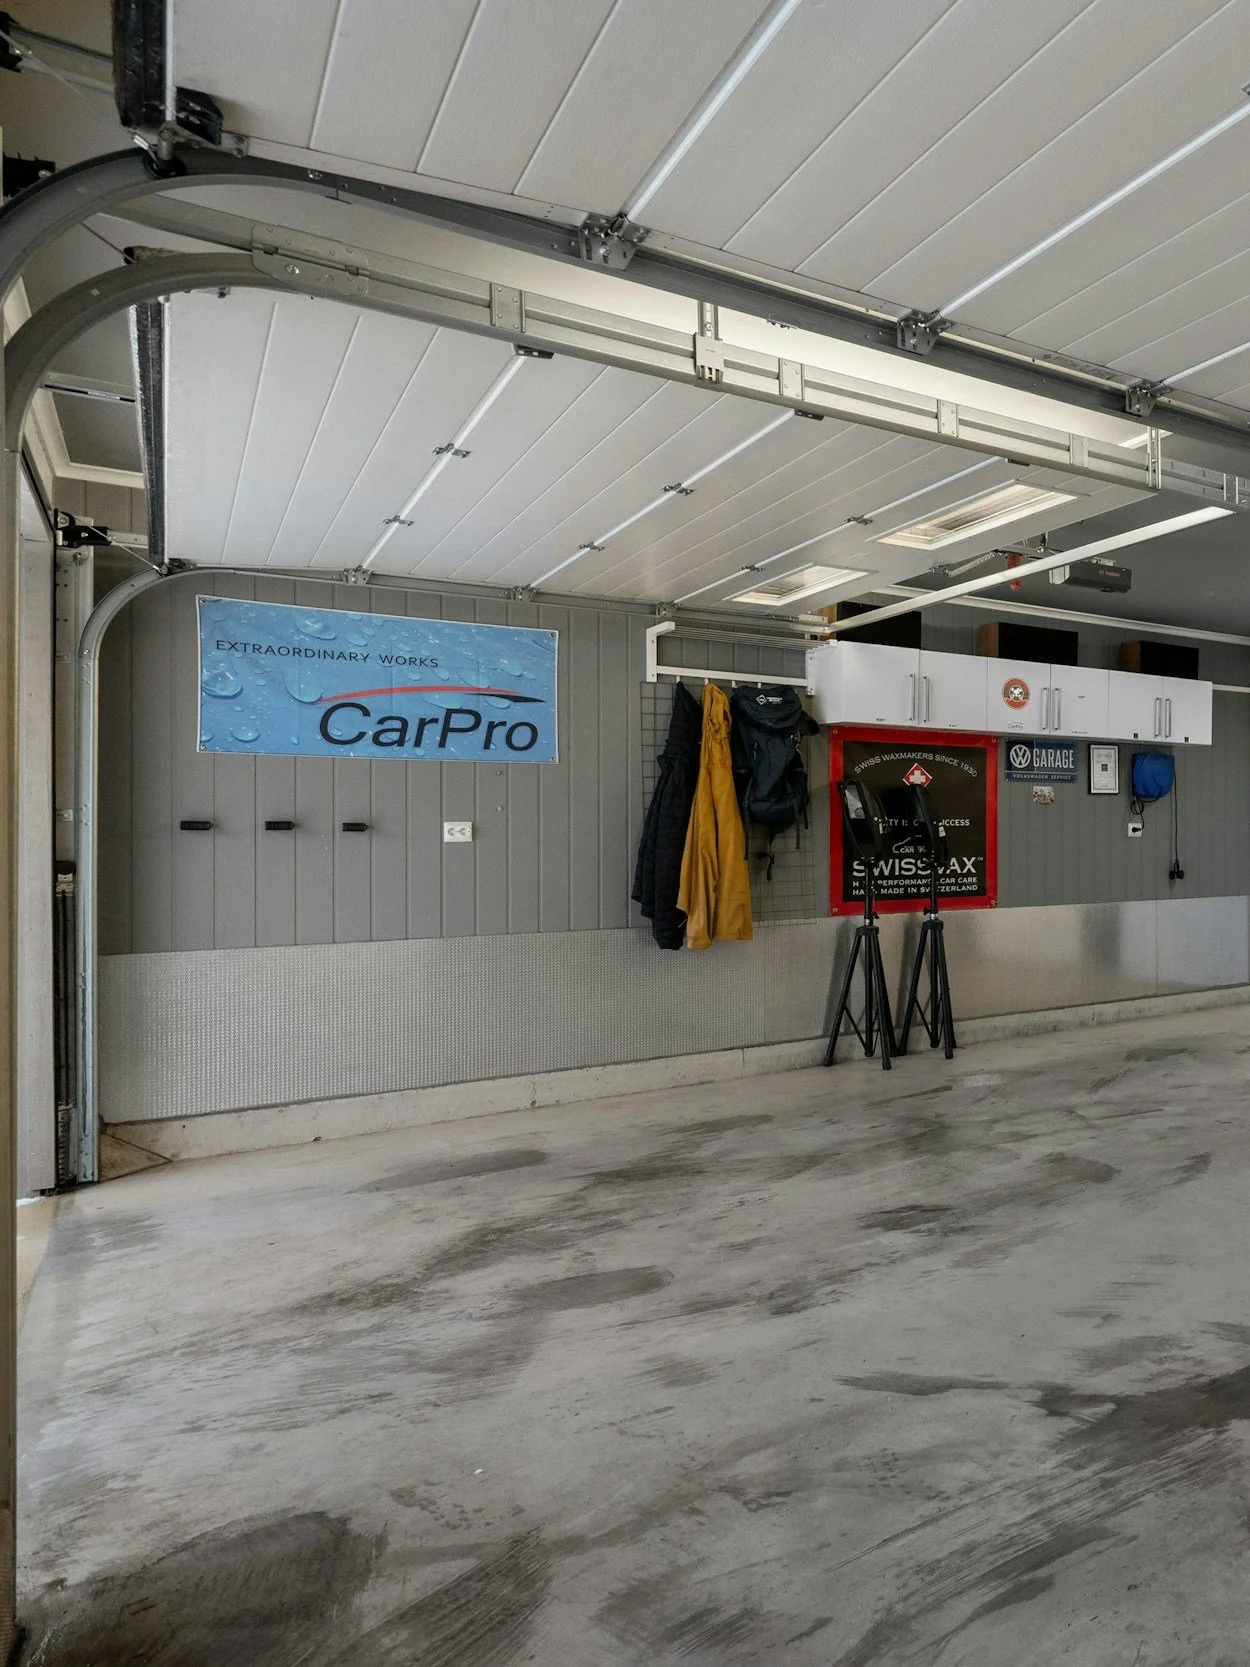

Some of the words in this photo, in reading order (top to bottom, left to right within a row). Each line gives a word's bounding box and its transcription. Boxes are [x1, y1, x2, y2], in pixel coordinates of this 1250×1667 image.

[216, 639, 371, 663] EXTRAORDINARY
[379, 653, 439, 668] WORKS
[319, 702, 539, 751] CarPro
[854, 756, 881, 774] SWISS
[882, 752, 934, 761] WAXMAKERS
[935, 754, 960, 767] SINCE
[960, 762, 978, 778] 1930
[1033, 748, 1075, 769] GARAGE
[878, 878, 936, 886] PERFORMAN
[881, 886, 905, 895] MADE
[908, 885, 917, 894] IN
[920, 884, 978, 893] SZERLAND
